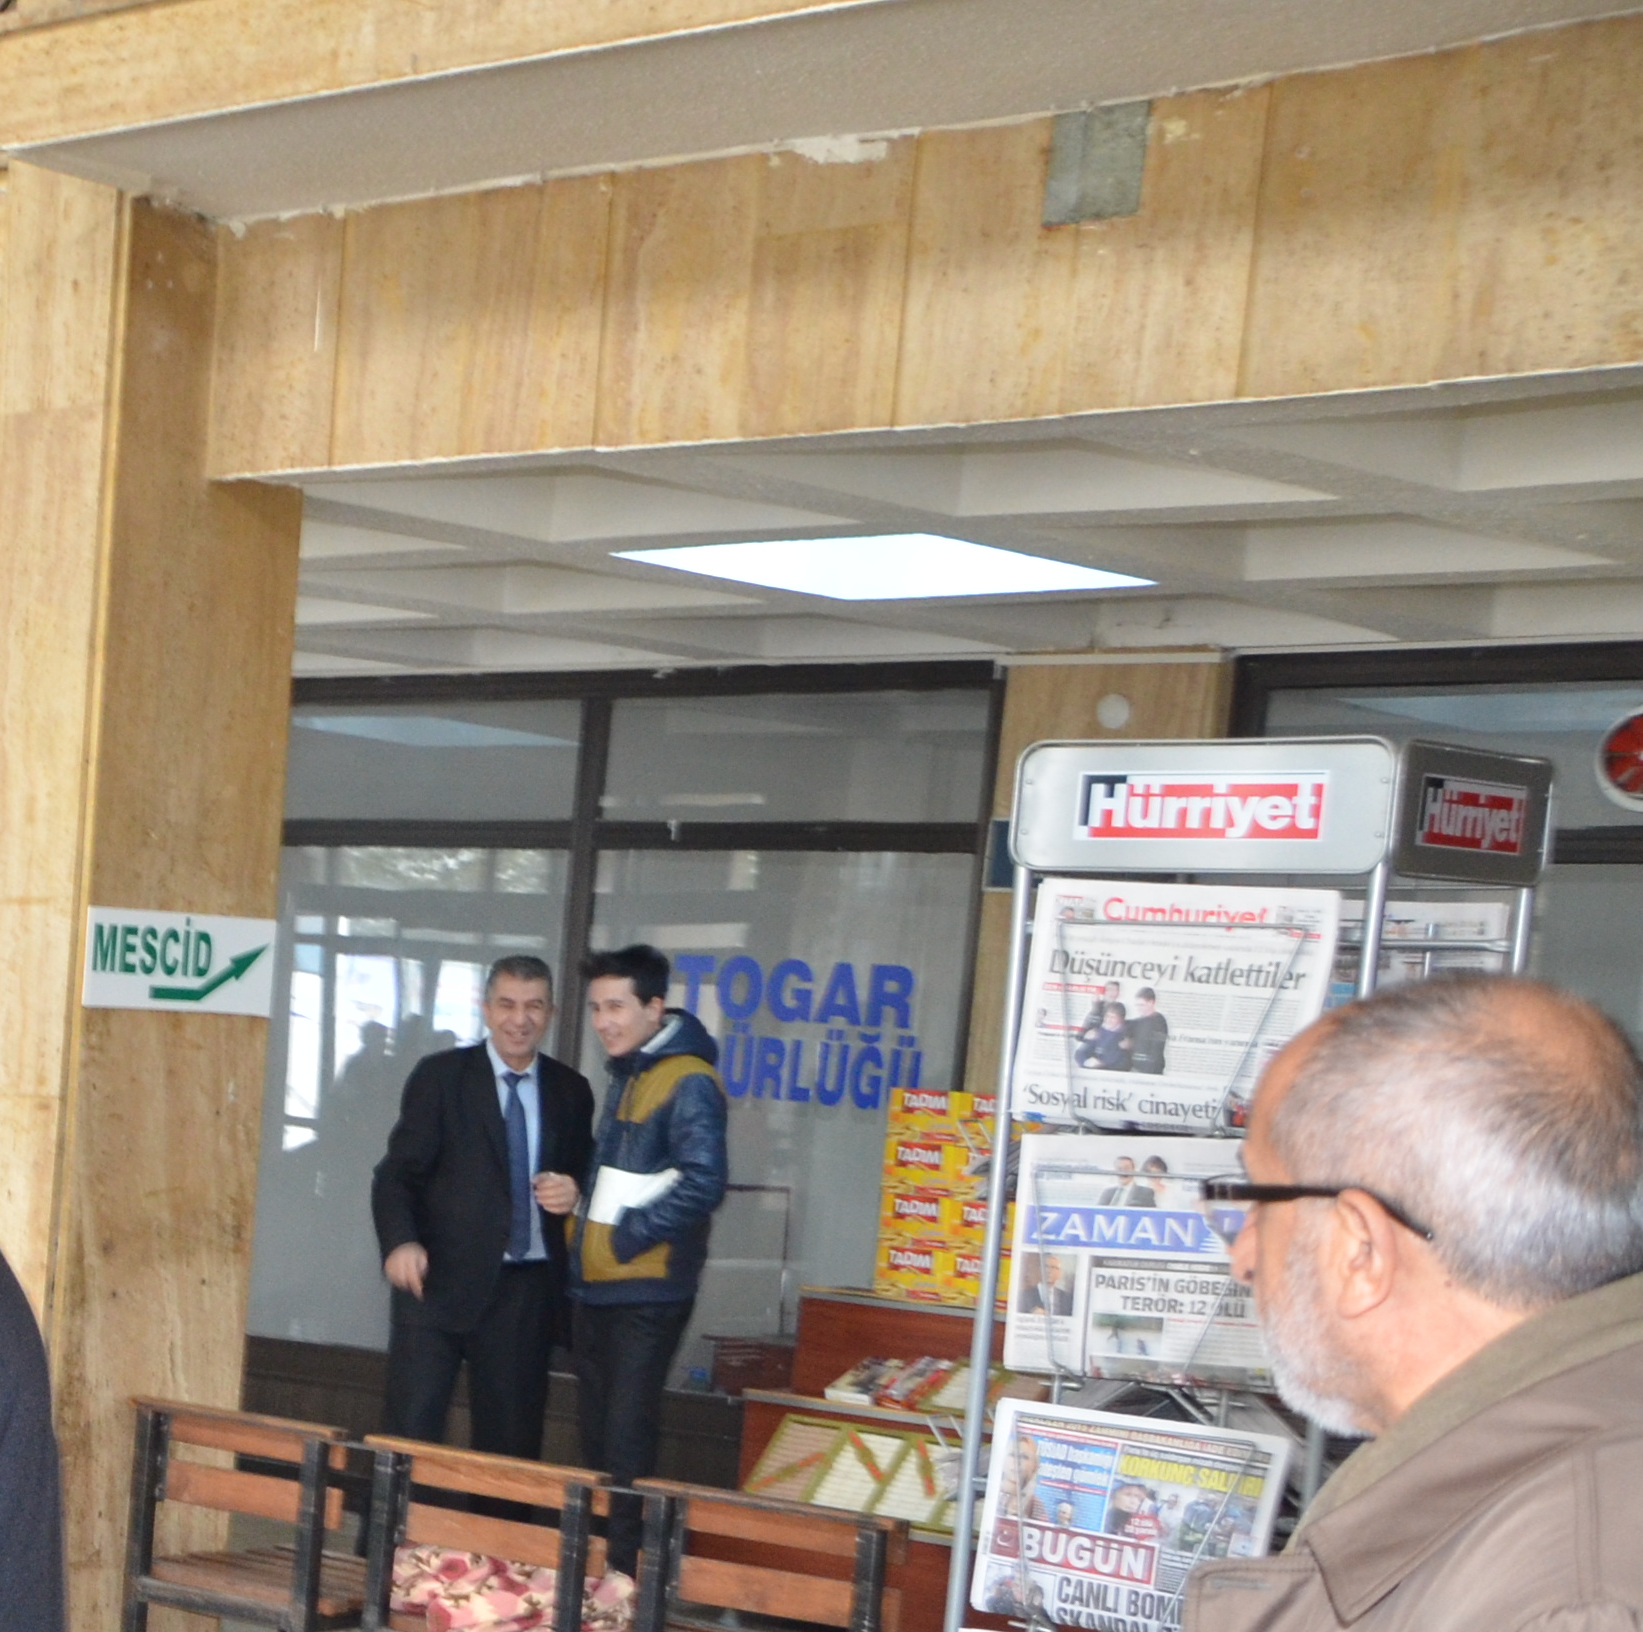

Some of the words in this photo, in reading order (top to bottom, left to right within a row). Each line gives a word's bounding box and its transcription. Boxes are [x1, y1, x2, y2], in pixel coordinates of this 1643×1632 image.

[1086, 779, 1320, 838] Hürriyet
[1423, 786, 1521, 849] Hürriyet
[91, 916, 213, 978] MESCİD
[1048, 948, 1179, 984] Düşünceyi
[718, 1024, 925, 1109] ÜRLÜĞÜ
[903, 1091, 948, 1110] TADIM
[896, 1146, 941, 1165] TADIM
[893, 1198, 938, 1217] TADIM
[1030, 1211, 1196, 1248] ZAMAN
[889, 1250, 933, 1269] TADIM
[1024, 1526, 1150, 1581] BUGÜN
[1056, 1575, 1120, 1614] CANLI
[1125, 1588, 1184, 1625] BOM
